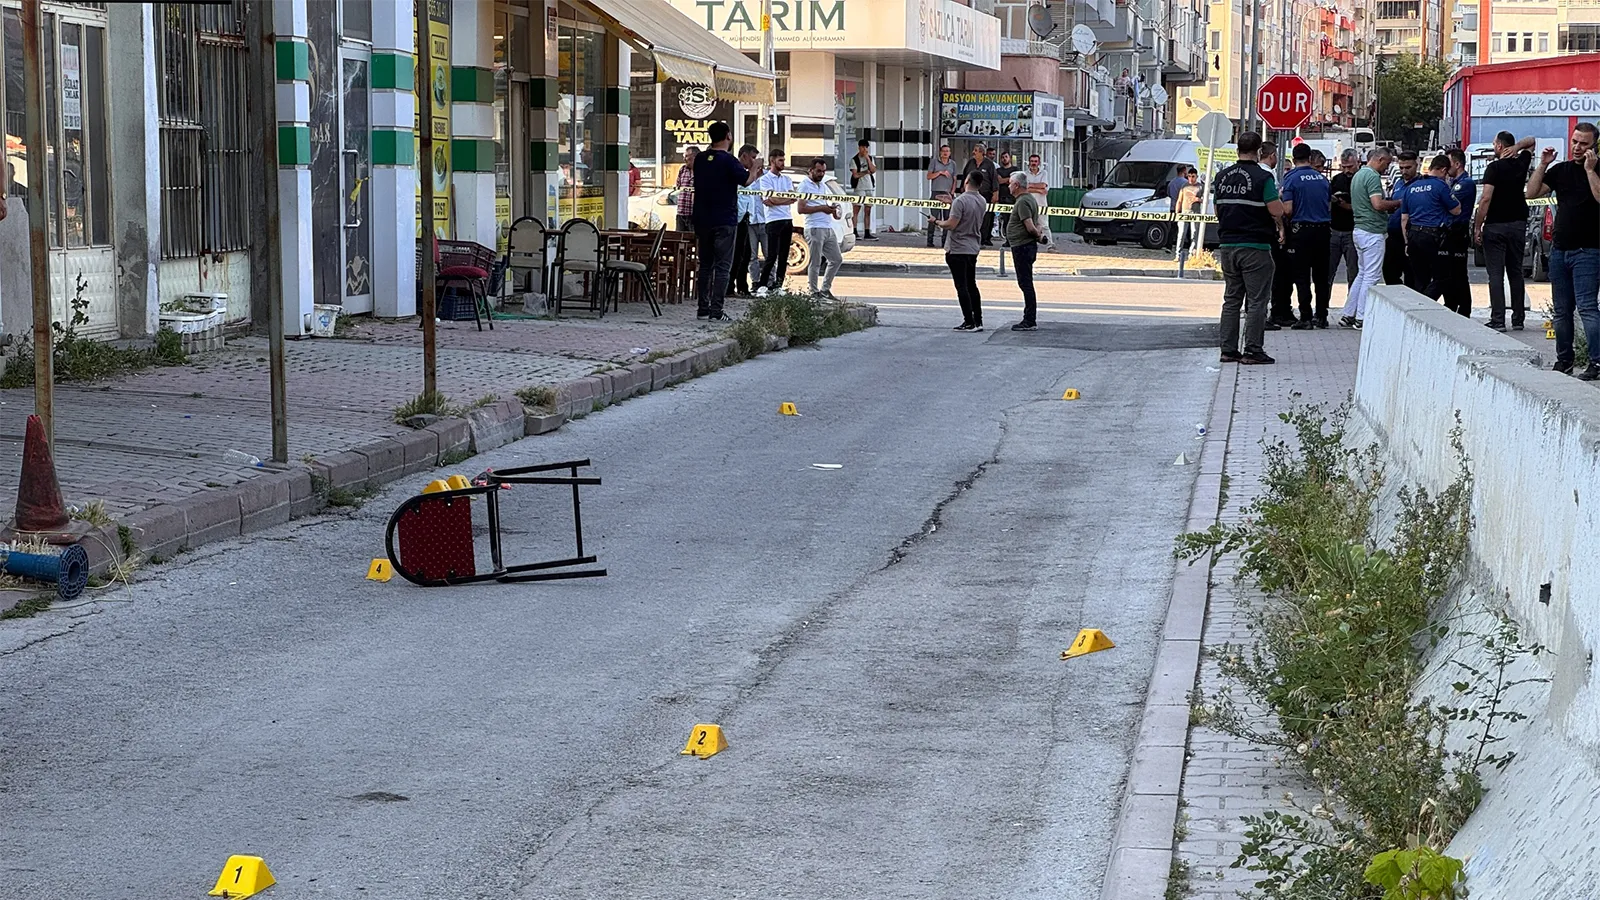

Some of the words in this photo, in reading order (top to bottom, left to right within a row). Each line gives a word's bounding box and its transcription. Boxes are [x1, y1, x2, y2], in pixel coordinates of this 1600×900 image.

[696, 0, 845, 31] TARIM
[943, 93, 976, 103] RASYON
[978, 94, 1032, 104] HAYVANCILIK
[1261, 91, 1308, 113] DUR
[959, 104, 983, 112] TARIM
[1220, 183, 1247, 195] POLİS
[375, 563, 382, 574] 4
[1078, 634, 1087, 648] 3
[697, 730, 707, 746] 2
[234, 865, 243, 884] 1
